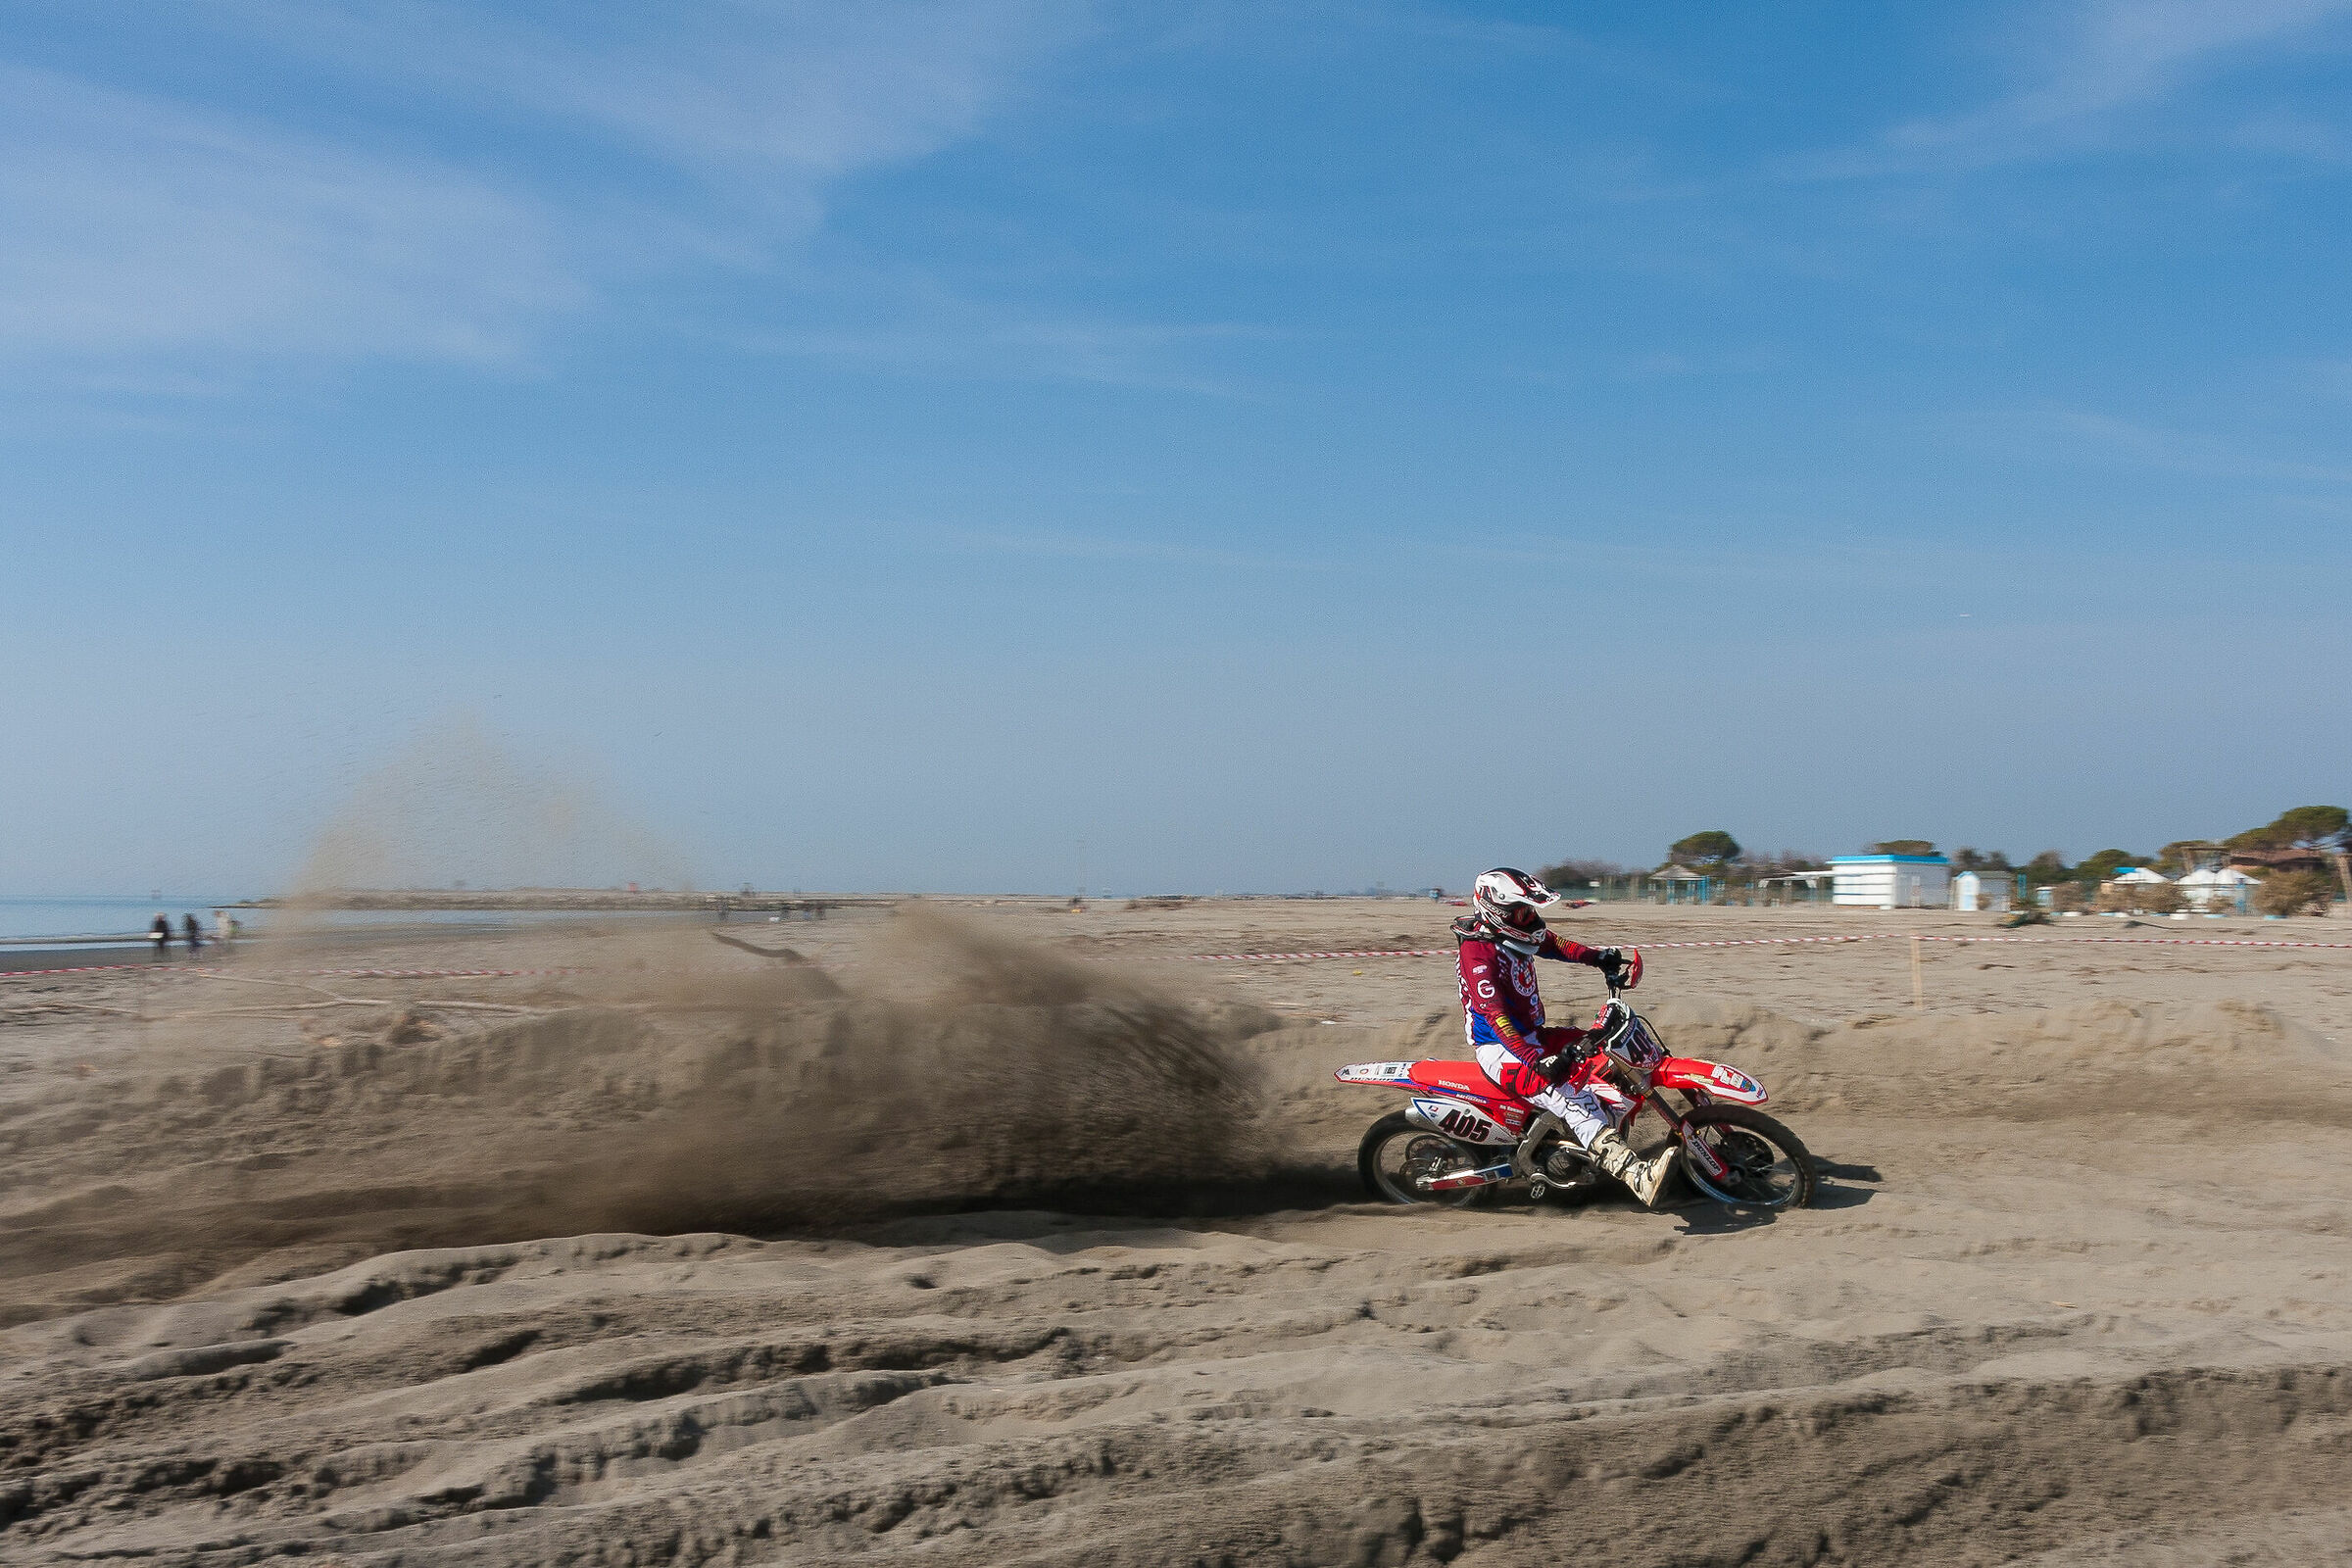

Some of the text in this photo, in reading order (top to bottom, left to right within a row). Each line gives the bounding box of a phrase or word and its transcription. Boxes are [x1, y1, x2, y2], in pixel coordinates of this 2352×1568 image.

[1477, 979, 1495, 999] G
[1438, 1079, 1470, 1091] HONDA
[1438, 1108, 1493, 1143] 405
[1691, 1140, 1722, 1172] DUNLOP
